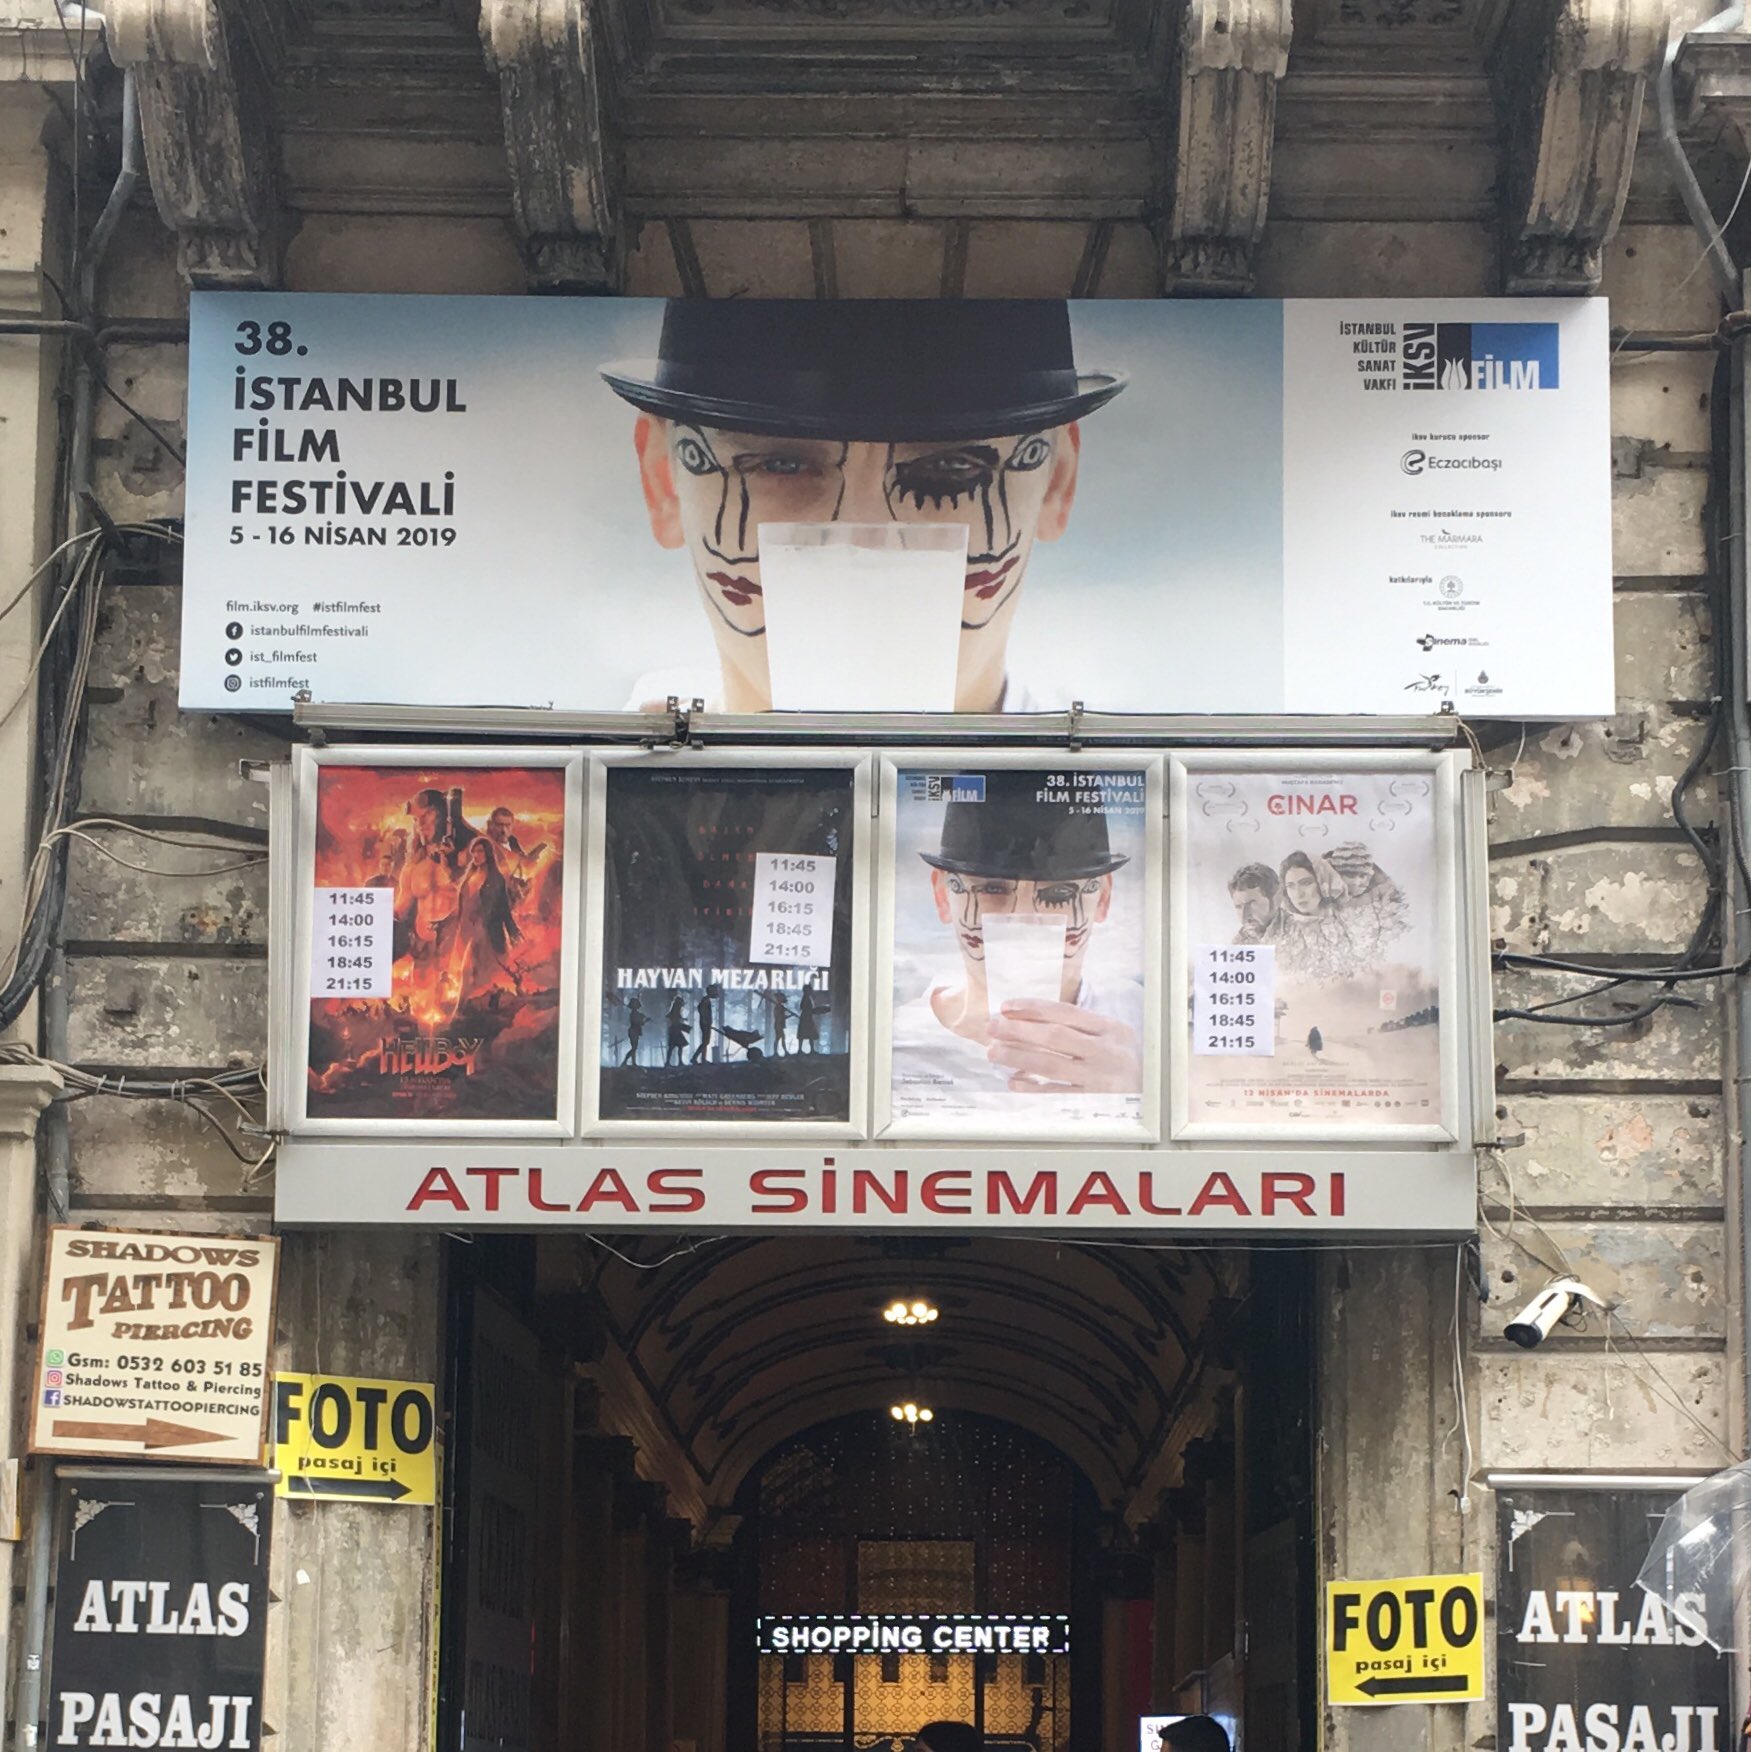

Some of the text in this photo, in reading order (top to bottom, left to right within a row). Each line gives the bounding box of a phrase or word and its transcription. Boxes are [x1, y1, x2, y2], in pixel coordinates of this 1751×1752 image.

[1339, 321, 1396, 335] İSTANBUL
[235, 321, 308, 356] 38.
[1353, 339, 1396, 354] KÜLTÜR
[1358, 360, 1396, 372] SANAT
[1472, 354, 1539, 389] FİLM
[234, 365, 466, 412] İSTANBUL
[1363, 379, 1396, 391] VAKFI
[233, 417, 340, 462] FİLM
[1428, 456, 1502, 471] Eczacıbaşı
[231, 470, 455, 515] FESTİVALİ
[230, 526, 243, 545] 5
[268, 526, 295, 545] 16
[304, 521, 387, 545] NİSAN
[397, 528, 456, 546] 2019
[226, 600, 381, 615] film.iksv.org #istfilmfest
[250, 625, 369, 637] istanbulfilmfestivali
[250, 651, 318, 664] ist_filmfest
[249, 677, 310, 689] istfilmfest
[1046, 772, 1145, 787] 38. İSTANBUL
[1036, 787, 1145, 803] FİLM FESTİVALİ
[1081, 806, 1091, 814] 16
[771, 859, 816, 872] 11:45
[769, 880, 814, 893] 14:00
[330, 893, 374, 904] 11:45
[768, 901, 813, 915] 16:15
[329, 914, 373, 926] 14:00
[766, 923, 812, 936] 18:45
[328, 935, 373, 947] 16:15
[764, 944, 811, 957] 21:15
[1210, 950, 1255, 962] 11:45
[327, 957, 372, 968] 18:45
[326, 978, 372, 990] 21:15
[617, 965, 829, 991] HAYVAN MEZARLIĞI
[1210, 972, 1255, 983] 14:00
[1209, 993, 1255, 1005] 16:15
[1209, 1014, 1255, 1026] 18:45
[1208, 1036, 1255, 1048] 21:15
[405, 1157, 1345, 1217] ATLAS SİNEMALARI
[65, 1239, 260, 1268] SHADOWS
[61, 1271, 251, 1331] TATTOO
[111, 1317, 253, 1341] PIERCING
[67, 1352, 262, 1377] Gsm: 0532 603 51 85
[65, 1373, 262, 1399] Shadows Tattoo & Piercing
[63, 1394, 261, 1416] SHADOWSTATTOOPIERCING
[277, 1381, 433, 1455] FOTO
[298, 1456, 396, 1476] pasaj içi
[73, 1579, 250, 1637] ATLAS
[1333, 1586, 1478, 1652] FOTO
[1517, 1590, 1709, 1647] ATLAS
[933, 1625, 1050, 1648] CENTER
[1355, 1654, 1446, 1674] pasaj içi
[57, 1692, 252, 1750] PASAJI
[1508, 1703, 1719, 1752] PASAJI
